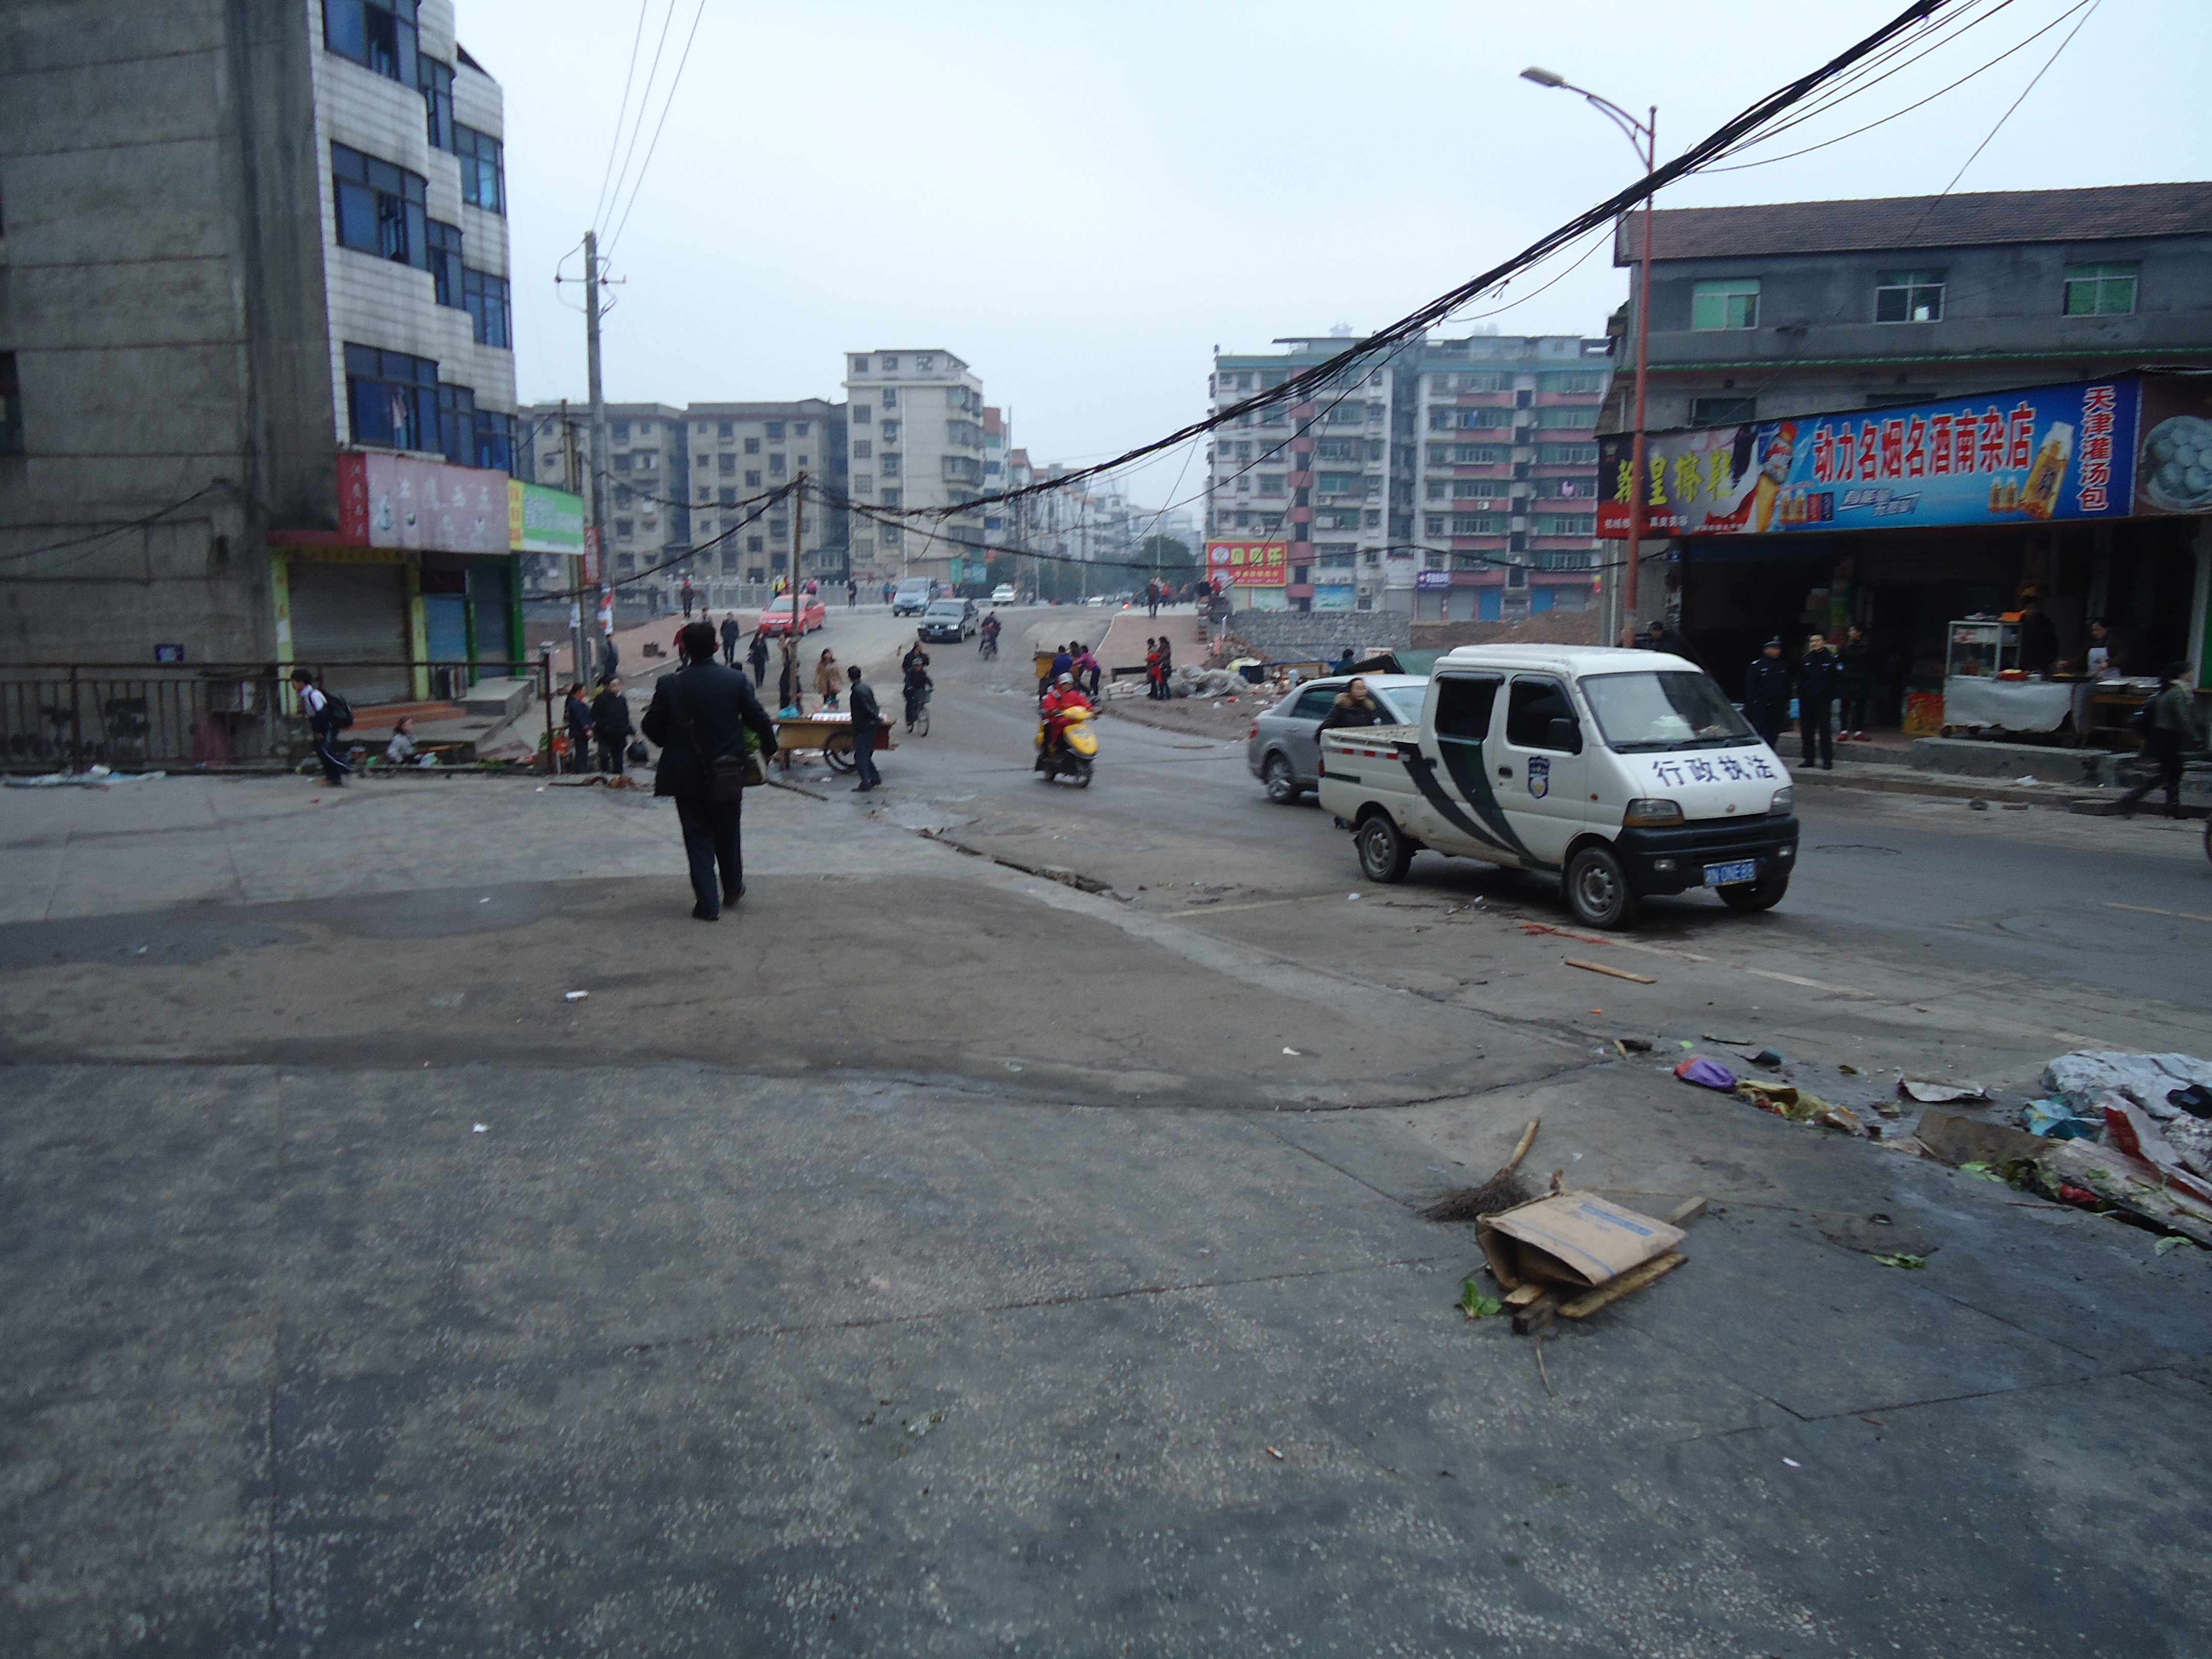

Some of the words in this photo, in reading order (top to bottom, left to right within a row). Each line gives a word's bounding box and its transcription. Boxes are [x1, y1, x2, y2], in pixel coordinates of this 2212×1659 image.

[1813, 400, 2035, 484] 动力名烟名酒南杂店
[2076, 385, 2117, 511] 天津灌汤包
[1652, 755, 1777, 786] 行政执法
